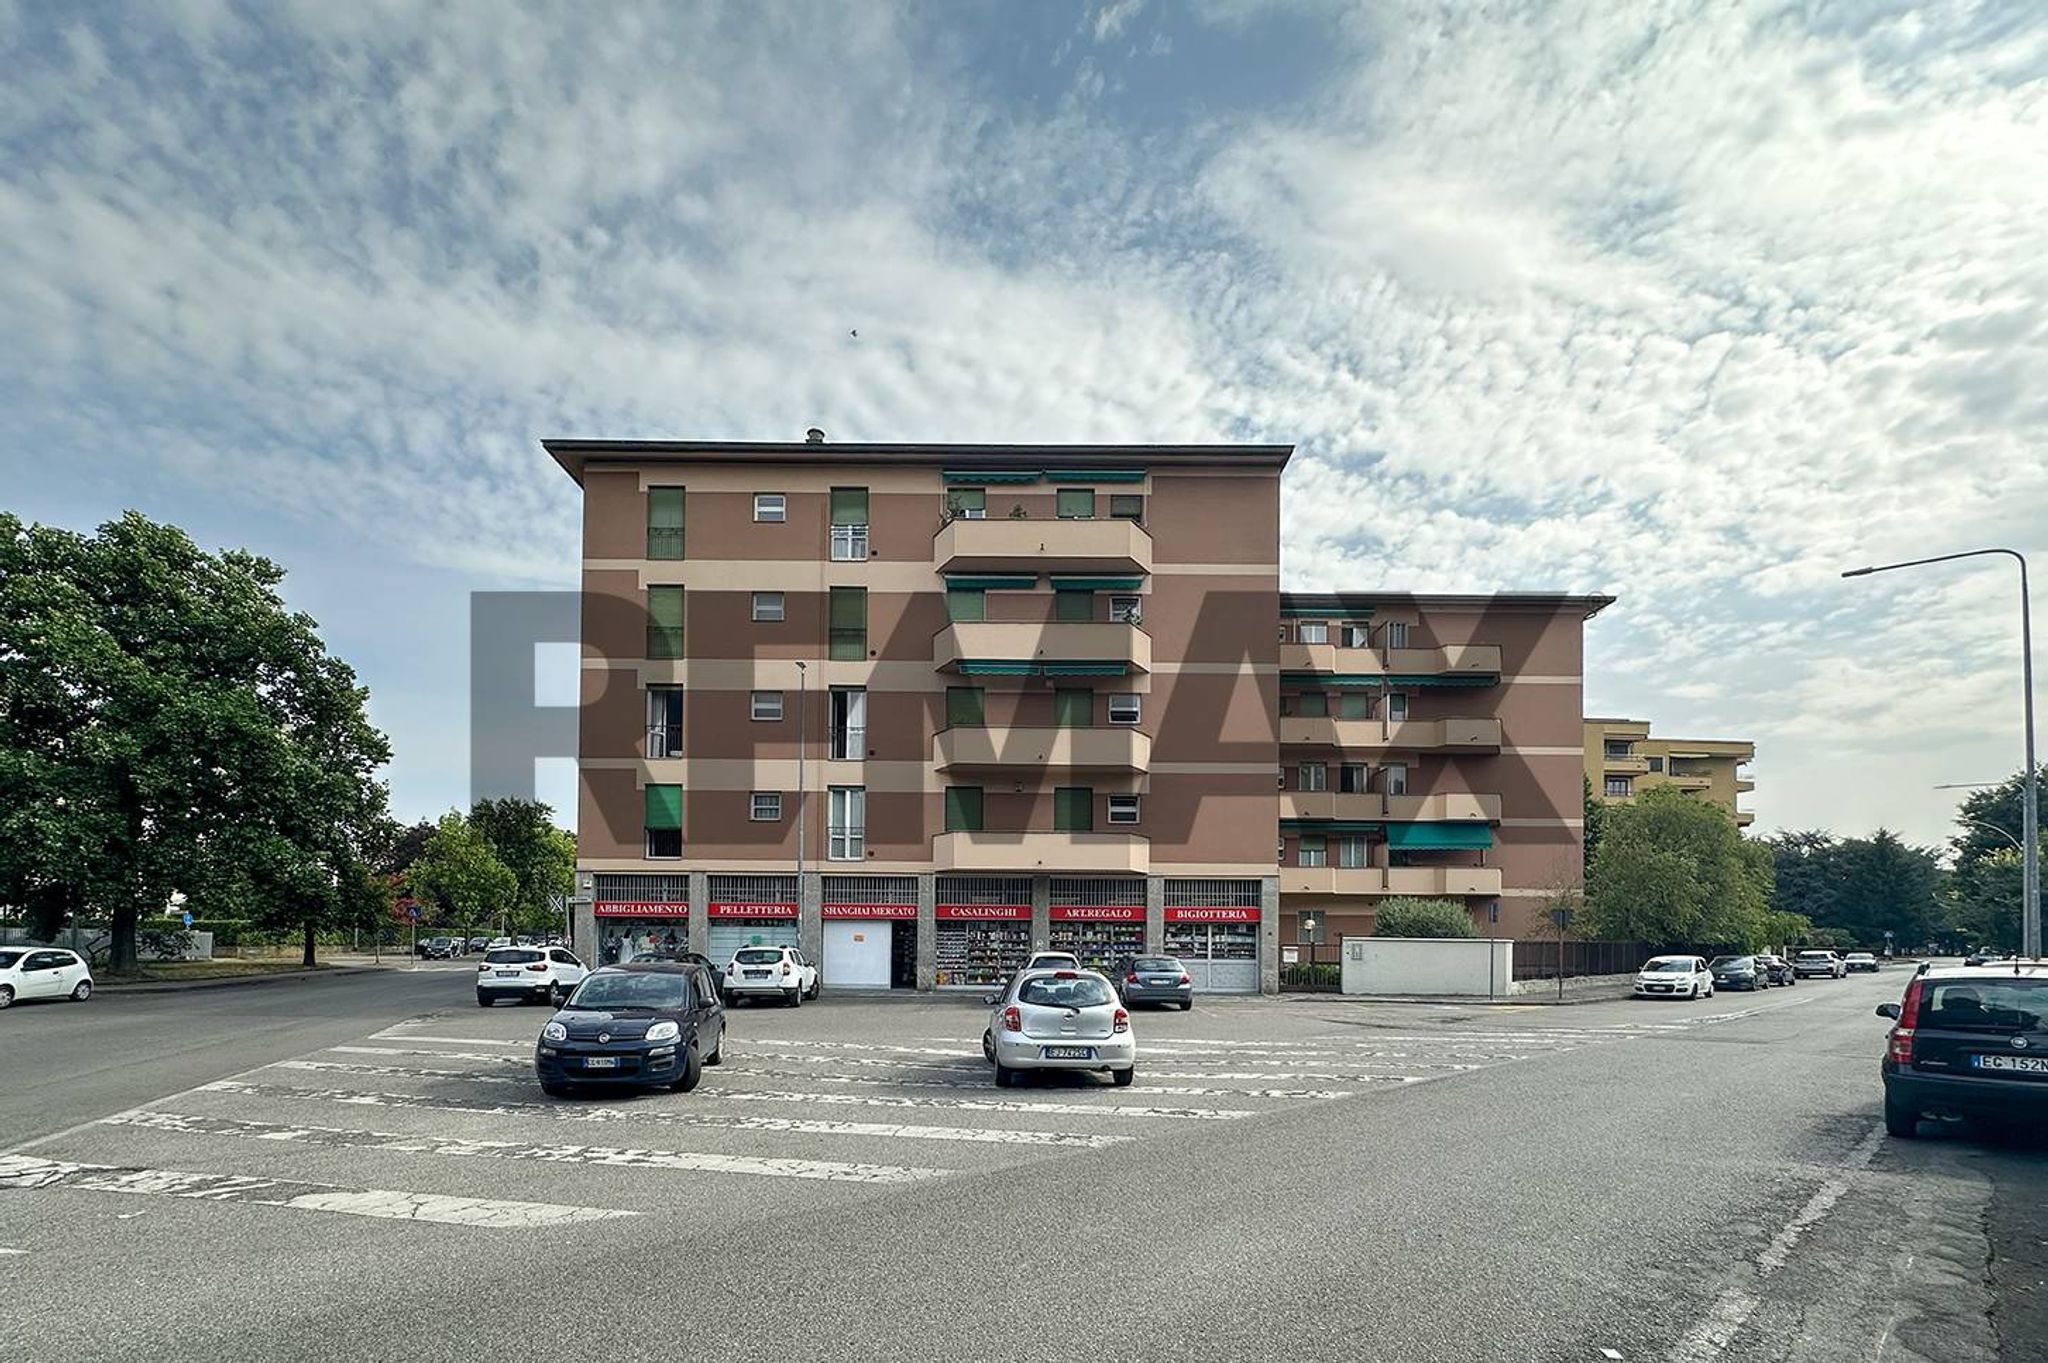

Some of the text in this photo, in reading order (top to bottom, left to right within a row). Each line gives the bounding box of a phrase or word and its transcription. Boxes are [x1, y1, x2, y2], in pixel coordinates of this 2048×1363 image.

[597, 904, 688, 914] ABBIGLIAMENTO
[720, 905, 793, 914] PELLETTERIA
[823, 906, 916, 916] SHANGHAI MERCATO
[950, 906, 1017, 917] CASALINGHI
[1176, 909, 1248, 919] BIGIOTTERIA
